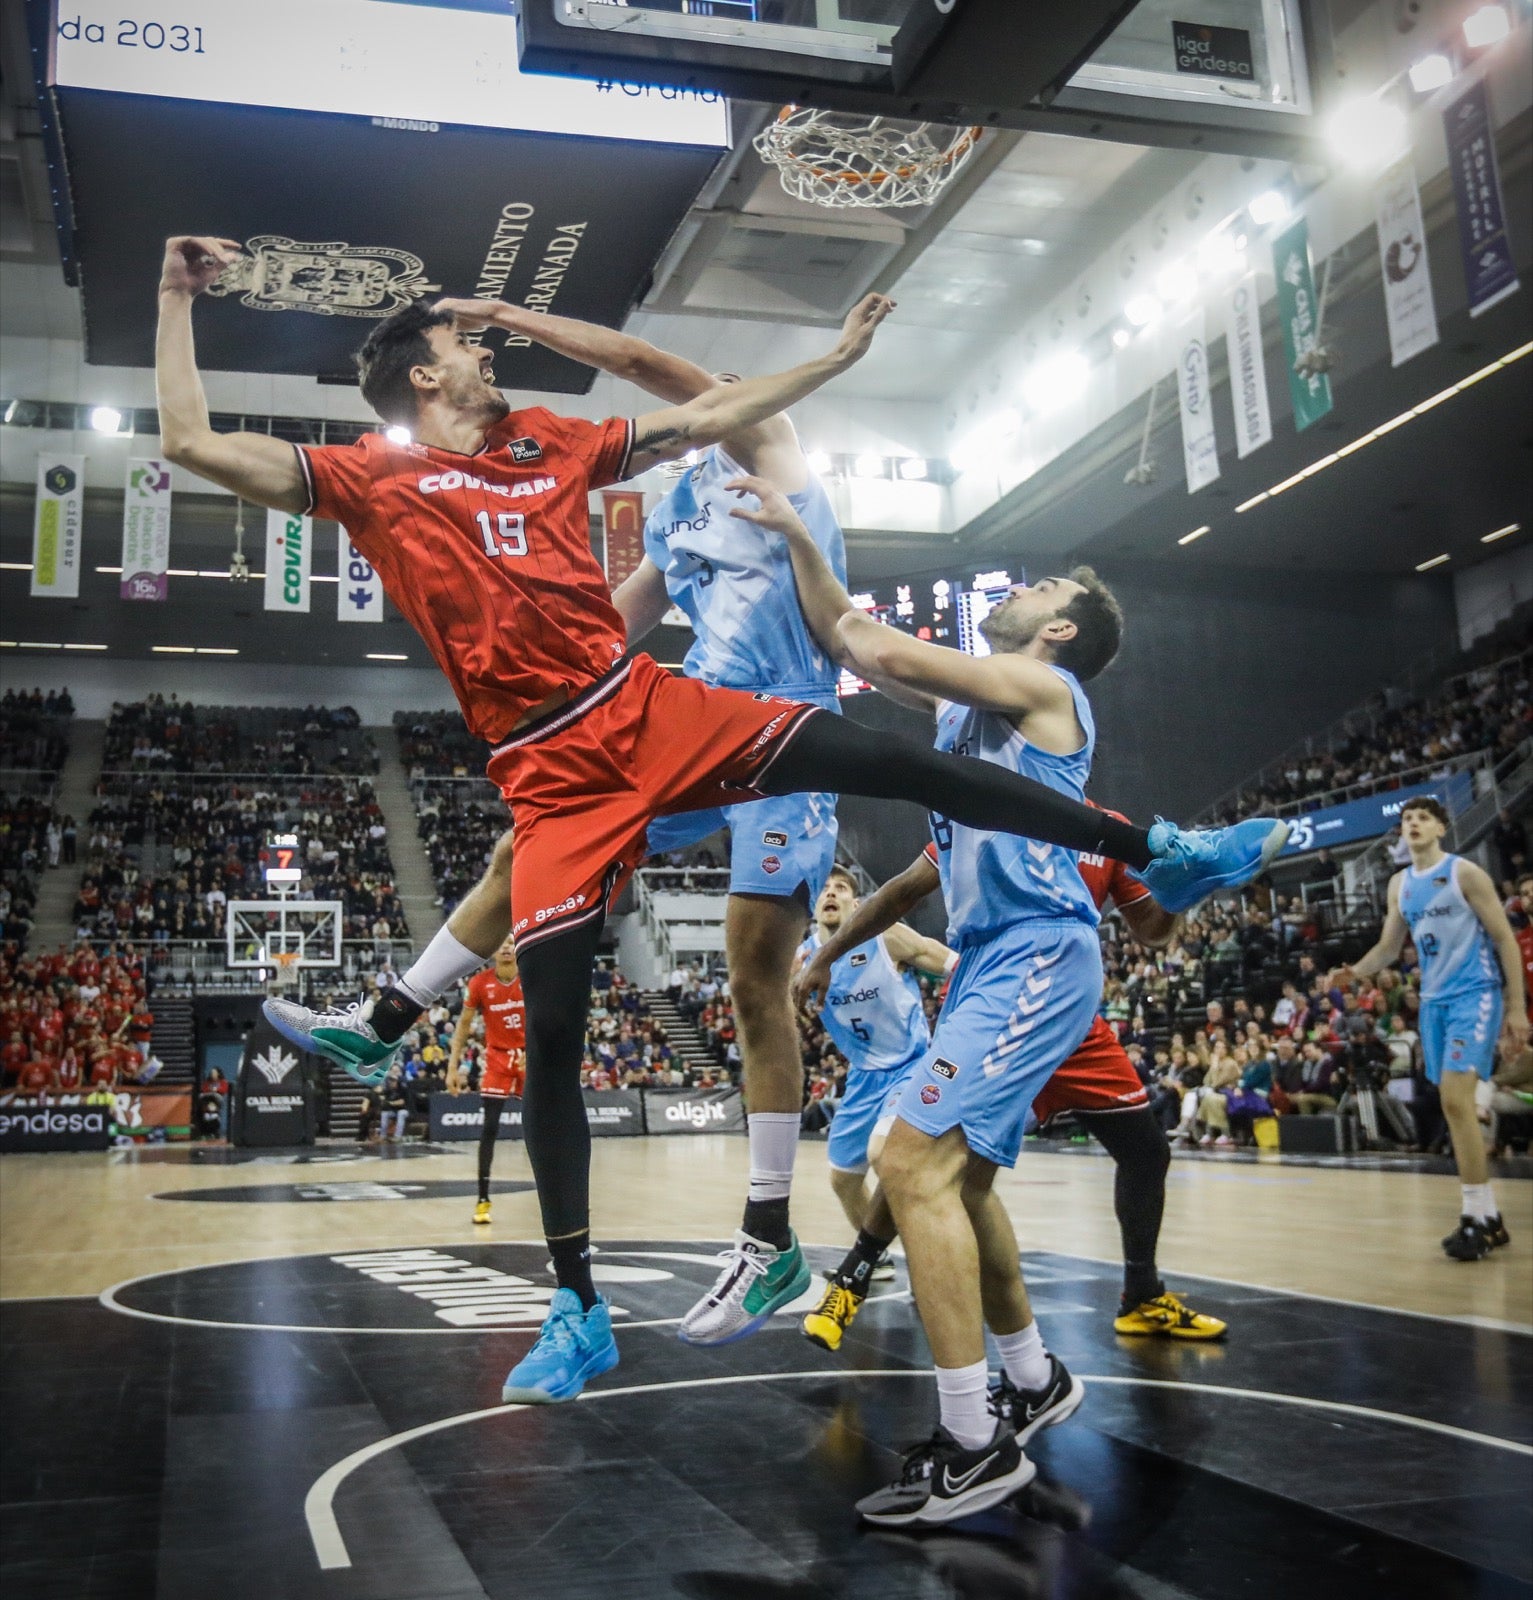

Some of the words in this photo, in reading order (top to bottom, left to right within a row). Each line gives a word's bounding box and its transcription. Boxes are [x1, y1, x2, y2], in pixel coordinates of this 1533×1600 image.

[58, 15, 104, 43] da
[117, 20, 205, 53] 2031
[1176, 35, 1210, 54] liga
[1179, 55, 1251, 75] endesa
[383, 118, 439, 132] MONDO
[418, 470, 557, 498] COVIRAN
[64, 500, 77, 568] cidesur
[475, 509, 529, 557] 19
[276, 850, 294, 869] 7
[1420, 932, 1439, 957] 12
[829, 986, 880, 1006] zunder
[503, 1013, 522, 1030] 32
[850, 1018, 871, 1041] 5
[933, 1063, 951, 1076] acb
[0, 1108, 104, 1135] endesa
[665, 1100, 727, 1128] alight
